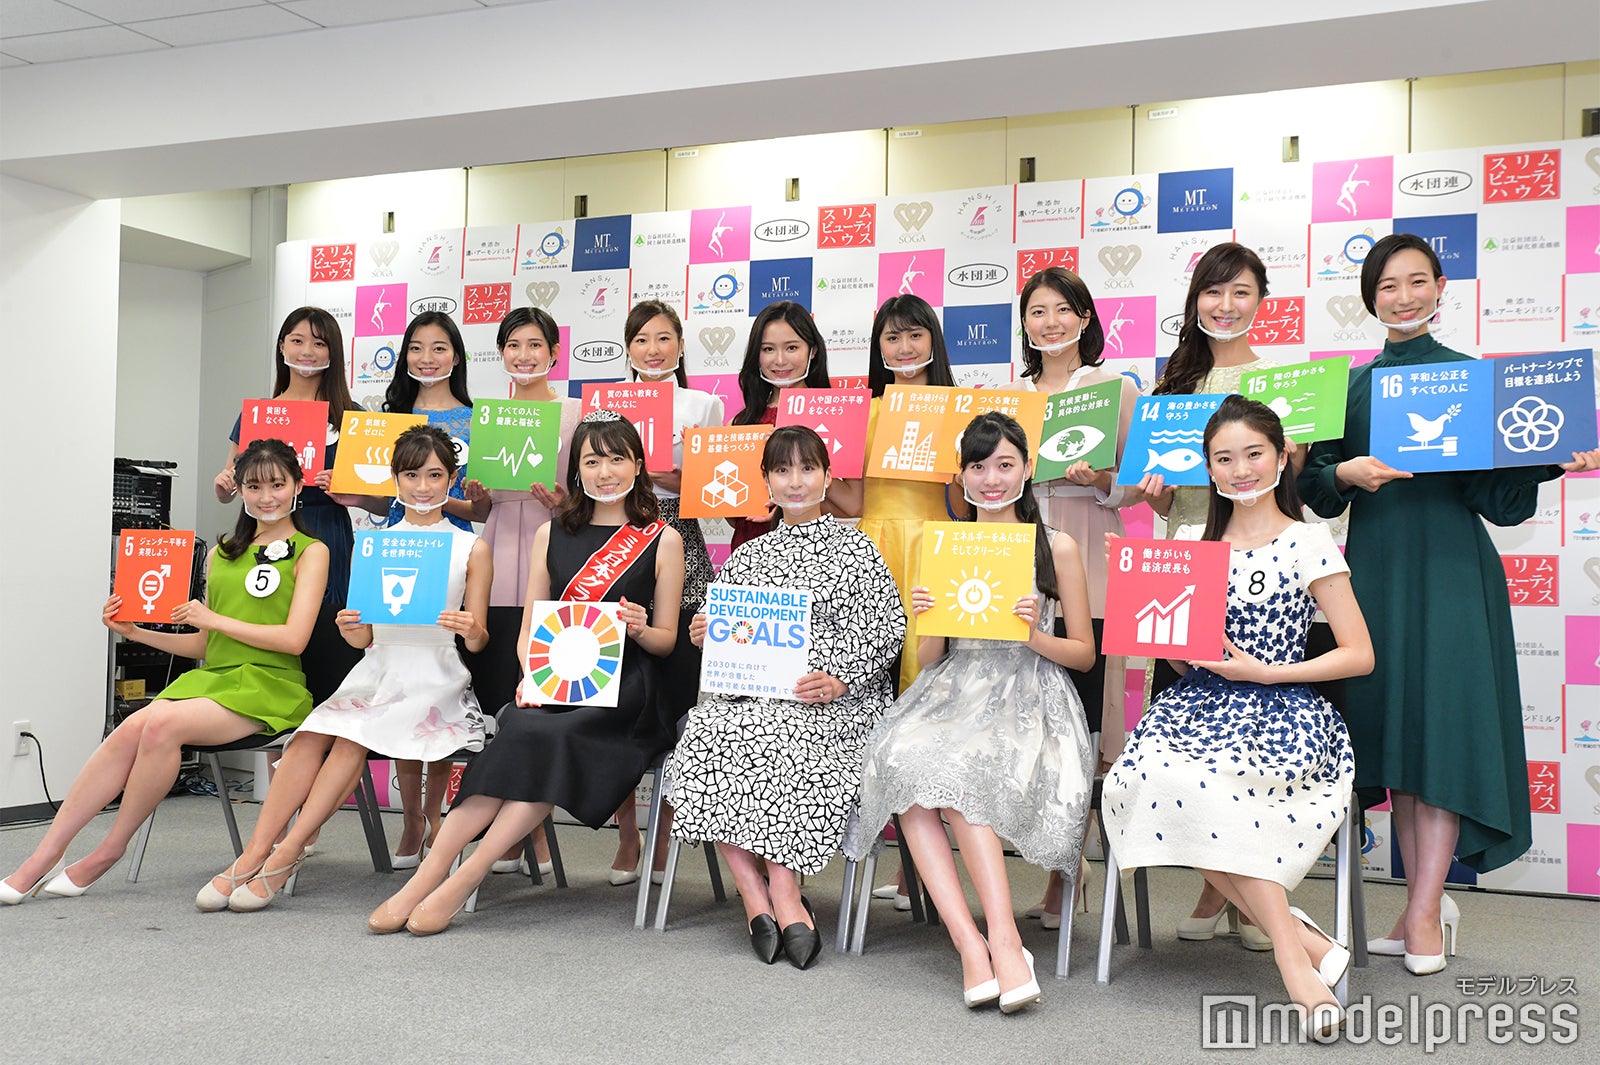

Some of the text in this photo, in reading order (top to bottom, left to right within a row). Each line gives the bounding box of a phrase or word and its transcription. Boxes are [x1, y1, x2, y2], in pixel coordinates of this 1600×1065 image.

[1490, 153, 1555, 170] スリム
[1410, 176, 1459, 190] 水団連
[1489, 169, 1556, 186] ビューティ
[1488, 184, 1556, 199] ハウス
[957, 192, 1002, 215] HANSHIN
[1172, 203, 1218, 213] METATRON
[822, 207, 872, 221] スリム
[763, 224, 800, 237] 水団連
[822, 220, 872, 234] ビューティ
[821, 232, 872, 245] ハウス
[898, 234, 926, 244] SOGA
[314, 245, 353, 258] スリム
[1169, 236, 1209, 261] HANSH
[313, 257, 353, 270] ビューティ
[1024, 251, 1074, 265] スリム
[312, 268, 353, 280] ハウス
[956, 269, 998, 282] 水団連
[581, 275, 620, 296] HANSHIN
[1104, 280, 1135, 289] SOGA
[468, 285, 508, 299] スリム
[761, 290, 800, 298] METATRON
[417, 301, 449, 312] 水団連
[467, 298, 509, 311] ビューティ
[1266, 300, 1300, 315] リム
[466, 309, 507, 321] ハウス
[1252, 315, 1300, 329] ューティ
[956, 338, 998, 347] METATRON
[1333, 331, 1368, 342] SOGA
[581, 346, 615, 358] 水団連
[703, 358, 730, 368] SOGA
[1504, 358, 1583, 375] パートナーシップで
[1273, 366, 1325, 381] 陸の豊かさも
[1410, 369, 1469, 382] 平和と公正を
[1505, 371, 1581, 388] 目標を達成しよう
[838, 379, 866, 389] リム
[1247, 375, 1267, 394] 15
[1273, 380, 1298, 390] 守ろう
[1380, 374, 1403, 398] 16
[1410, 383, 1469, 396] すべての人に
[589, 390, 601, 409] 4
[607, 389, 659, 398] 質の高い教育を
[808, 395, 864, 405] 人や国の不平等
[909, 392, 949, 403] 住み続けら
[1058, 391, 1098, 408] 気候変動に
[607, 400, 637, 409] みんなに
[787, 395, 805, 416] 10
[889, 391, 904, 412] 11
[954, 394, 973, 413] 12
[979, 396, 1020, 406] つくる責任
[1166, 401, 1218, 410] 海の豊かさを
[266, 406, 288, 415] 貧困を
[497, 406, 540, 416] すべての人に
[808, 406, 844, 416] をなくそう
[1044, 403, 1054, 421] 3
[1057, 398, 1111, 418] 具体的な対策を
[1140, 402, 1160, 422] 14
[252, 406, 259, 424] 1
[265, 417, 291, 426] なくそう
[479, 405, 490, 425] 3
[1166, 411, 1189, 421] 守ろう
[348, 417, 359, 435] 2
[496, 417, 542, 427] 健康と福祉を
[364, 429, 386, 437] ゼロに
[707, 432, 766, 443] 産業と技術革新の
[691, 434, 702, 454] 9
[707, 443, 756, 453] 基盤をつくろう
[139, 537, 187, 548] ジェンダー平等を
[382, 537, 444, 548] 安全な水とトイレ
[933, 530, 945, 555] 7
[952, 531, 1031, 543] エネルギーをみんなに
[125, 536, 135, 556] 5
[138, 547, 169, 557] 実現しよう
[361, 537, 374, 558] 6
[952, 545, 1011, 556] そしてクリーンに
[381, 549, 422, 558] を世界中に
[1119, 546, 1133, 572] 8
[1143, 548, 1192, 560] 働きがいも
[570, 534, 639, 602] ミス日本グラ
[1141, 562, 1191, 574] 経済成長も
[1514, 558, 1553, 573] リム
[255, 569, 270, 592] 5
[1248, 570, 1265, 595] 8
[1506, 574, 1554, 589] ューティ
[710, 587, 808, 608] SUSTAINABLE
[1513, 589, 1554, 603] ウス
[709, 603, 806, 622] DEVELOPMENT
[708, 618, 805, 649] GOALS
[707, 660, 767, 672] 2030年に向けて
[706, 671, 755, 681] 世界が合意した
